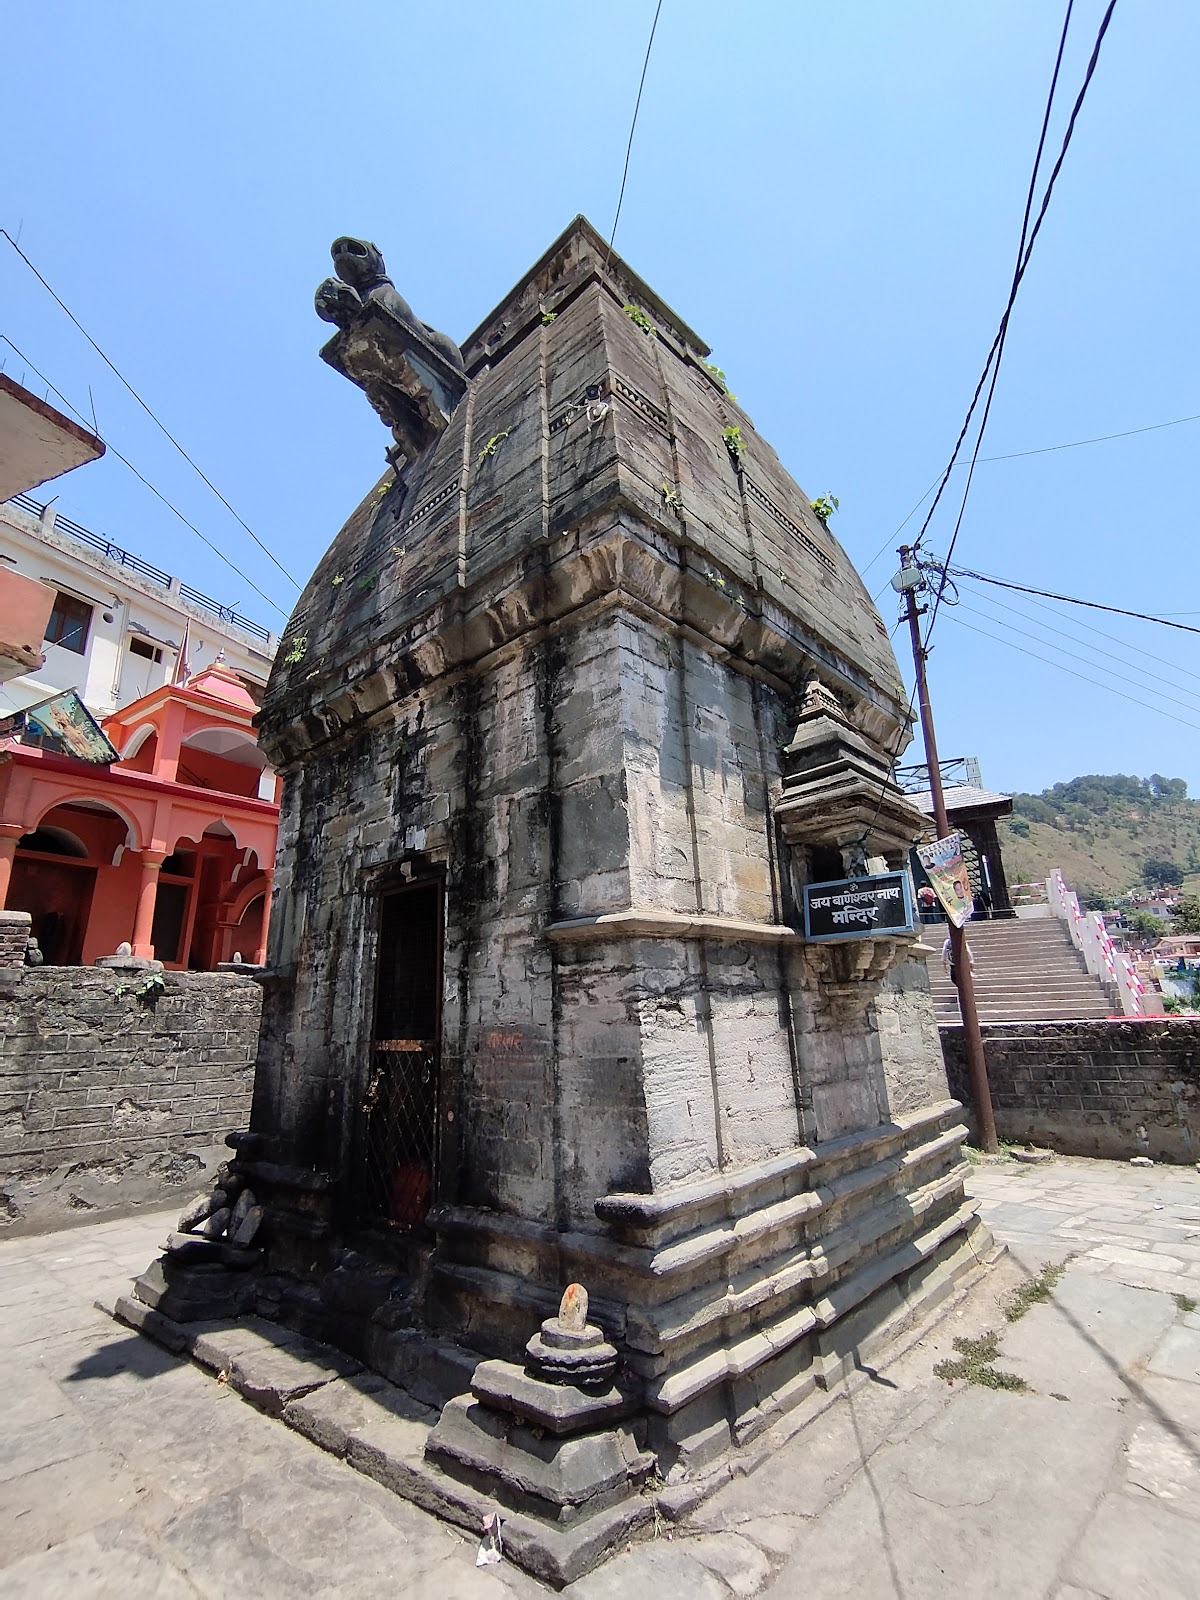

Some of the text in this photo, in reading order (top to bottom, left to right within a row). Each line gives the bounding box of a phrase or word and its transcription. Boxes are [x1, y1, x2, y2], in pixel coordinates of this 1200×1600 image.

[849, 883, 858, 891] ॐ
[810, 897, 831, 909] जय
[876, 887, 900, 899] नाथ
[831, 905, 879, 924] मन्दिर
